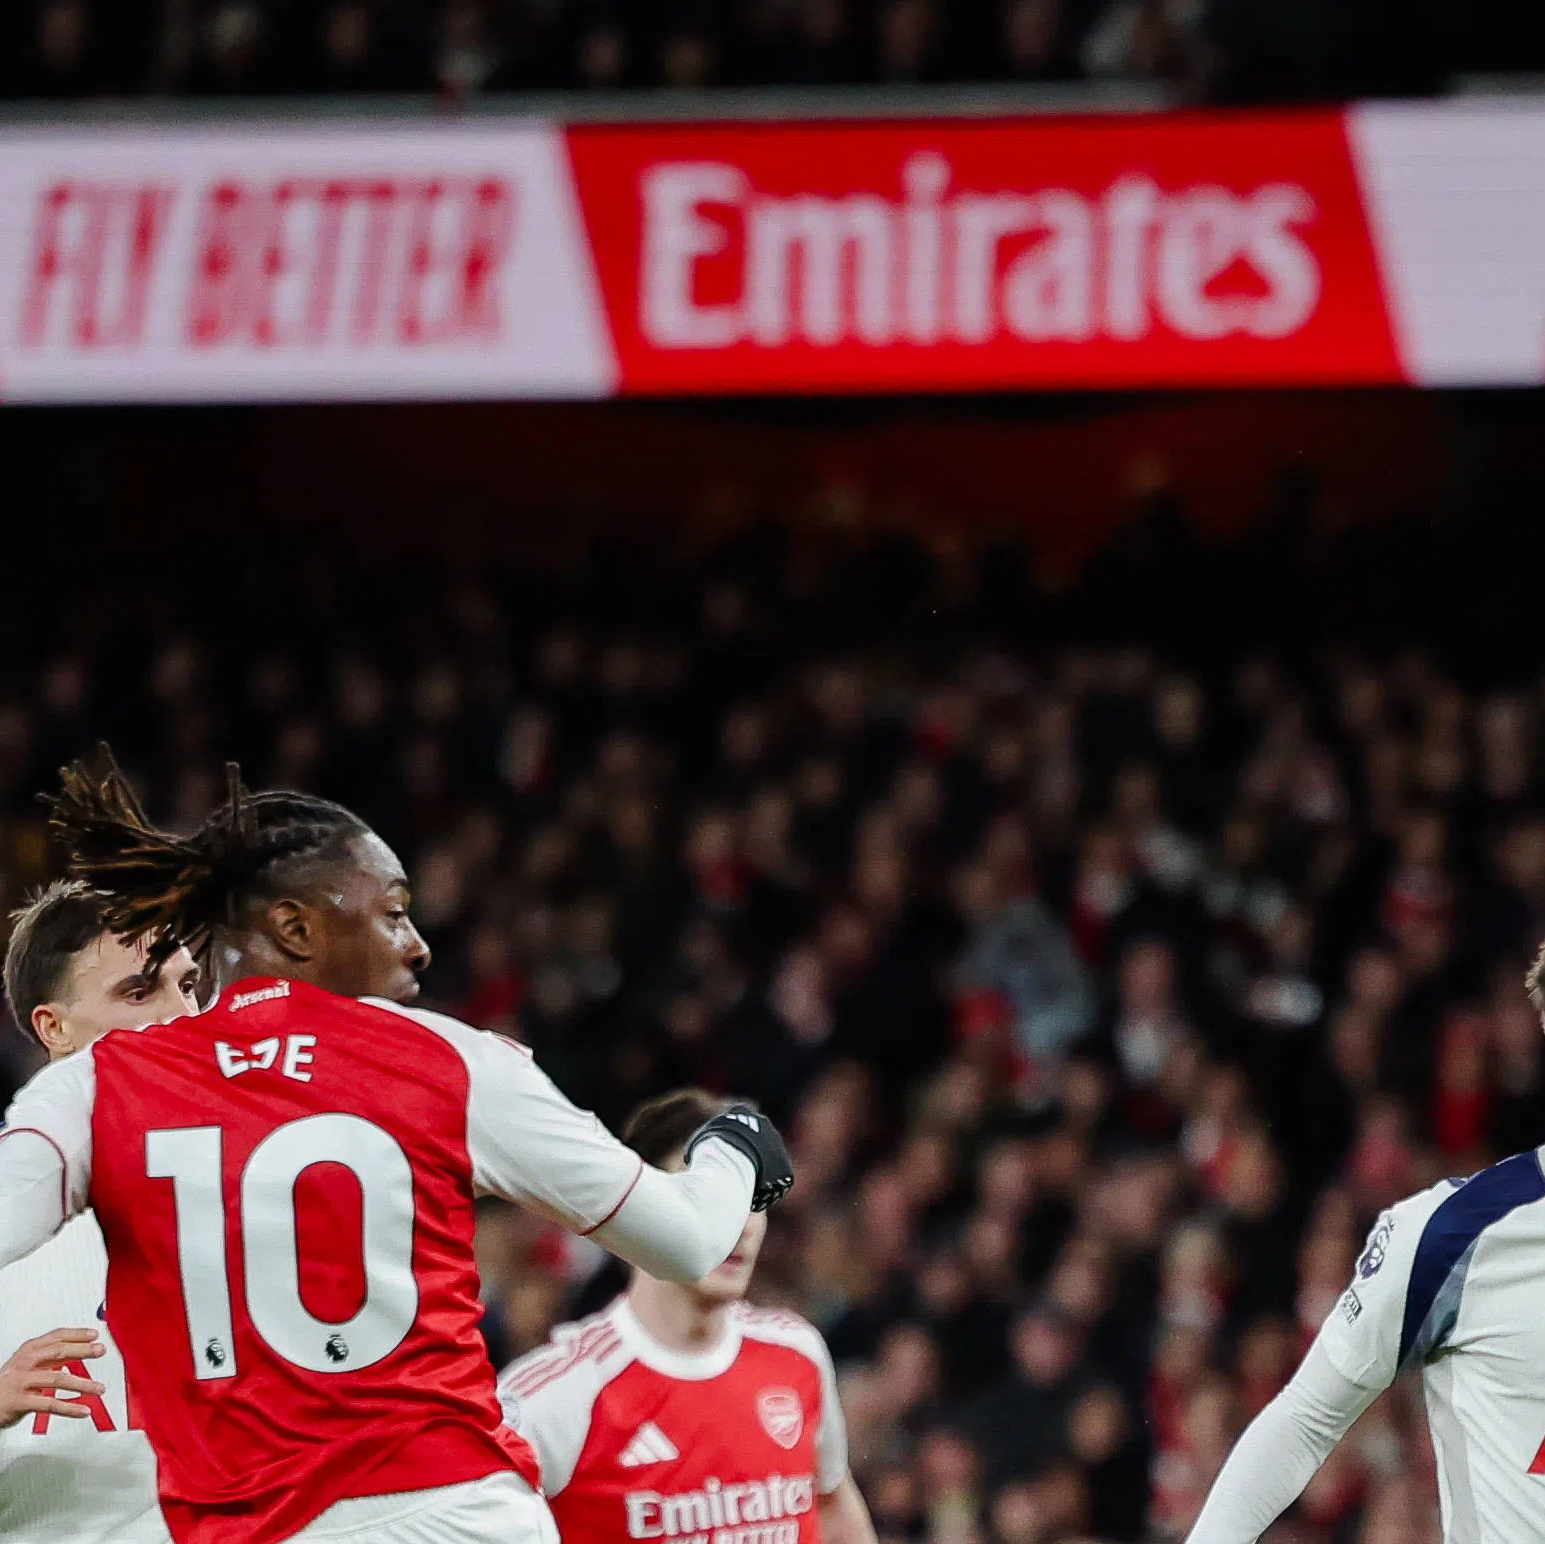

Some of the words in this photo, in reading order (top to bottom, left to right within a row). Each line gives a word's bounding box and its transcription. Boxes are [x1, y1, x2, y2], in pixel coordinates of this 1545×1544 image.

[22, 178, 177, 346] FLY
[187, 174, 521, 348] BETTER
[641, 150, 1323, 348] Emirates
[228, 979, 291, 1012] Arsenal
[144, 1111, 419, 1381] 10
